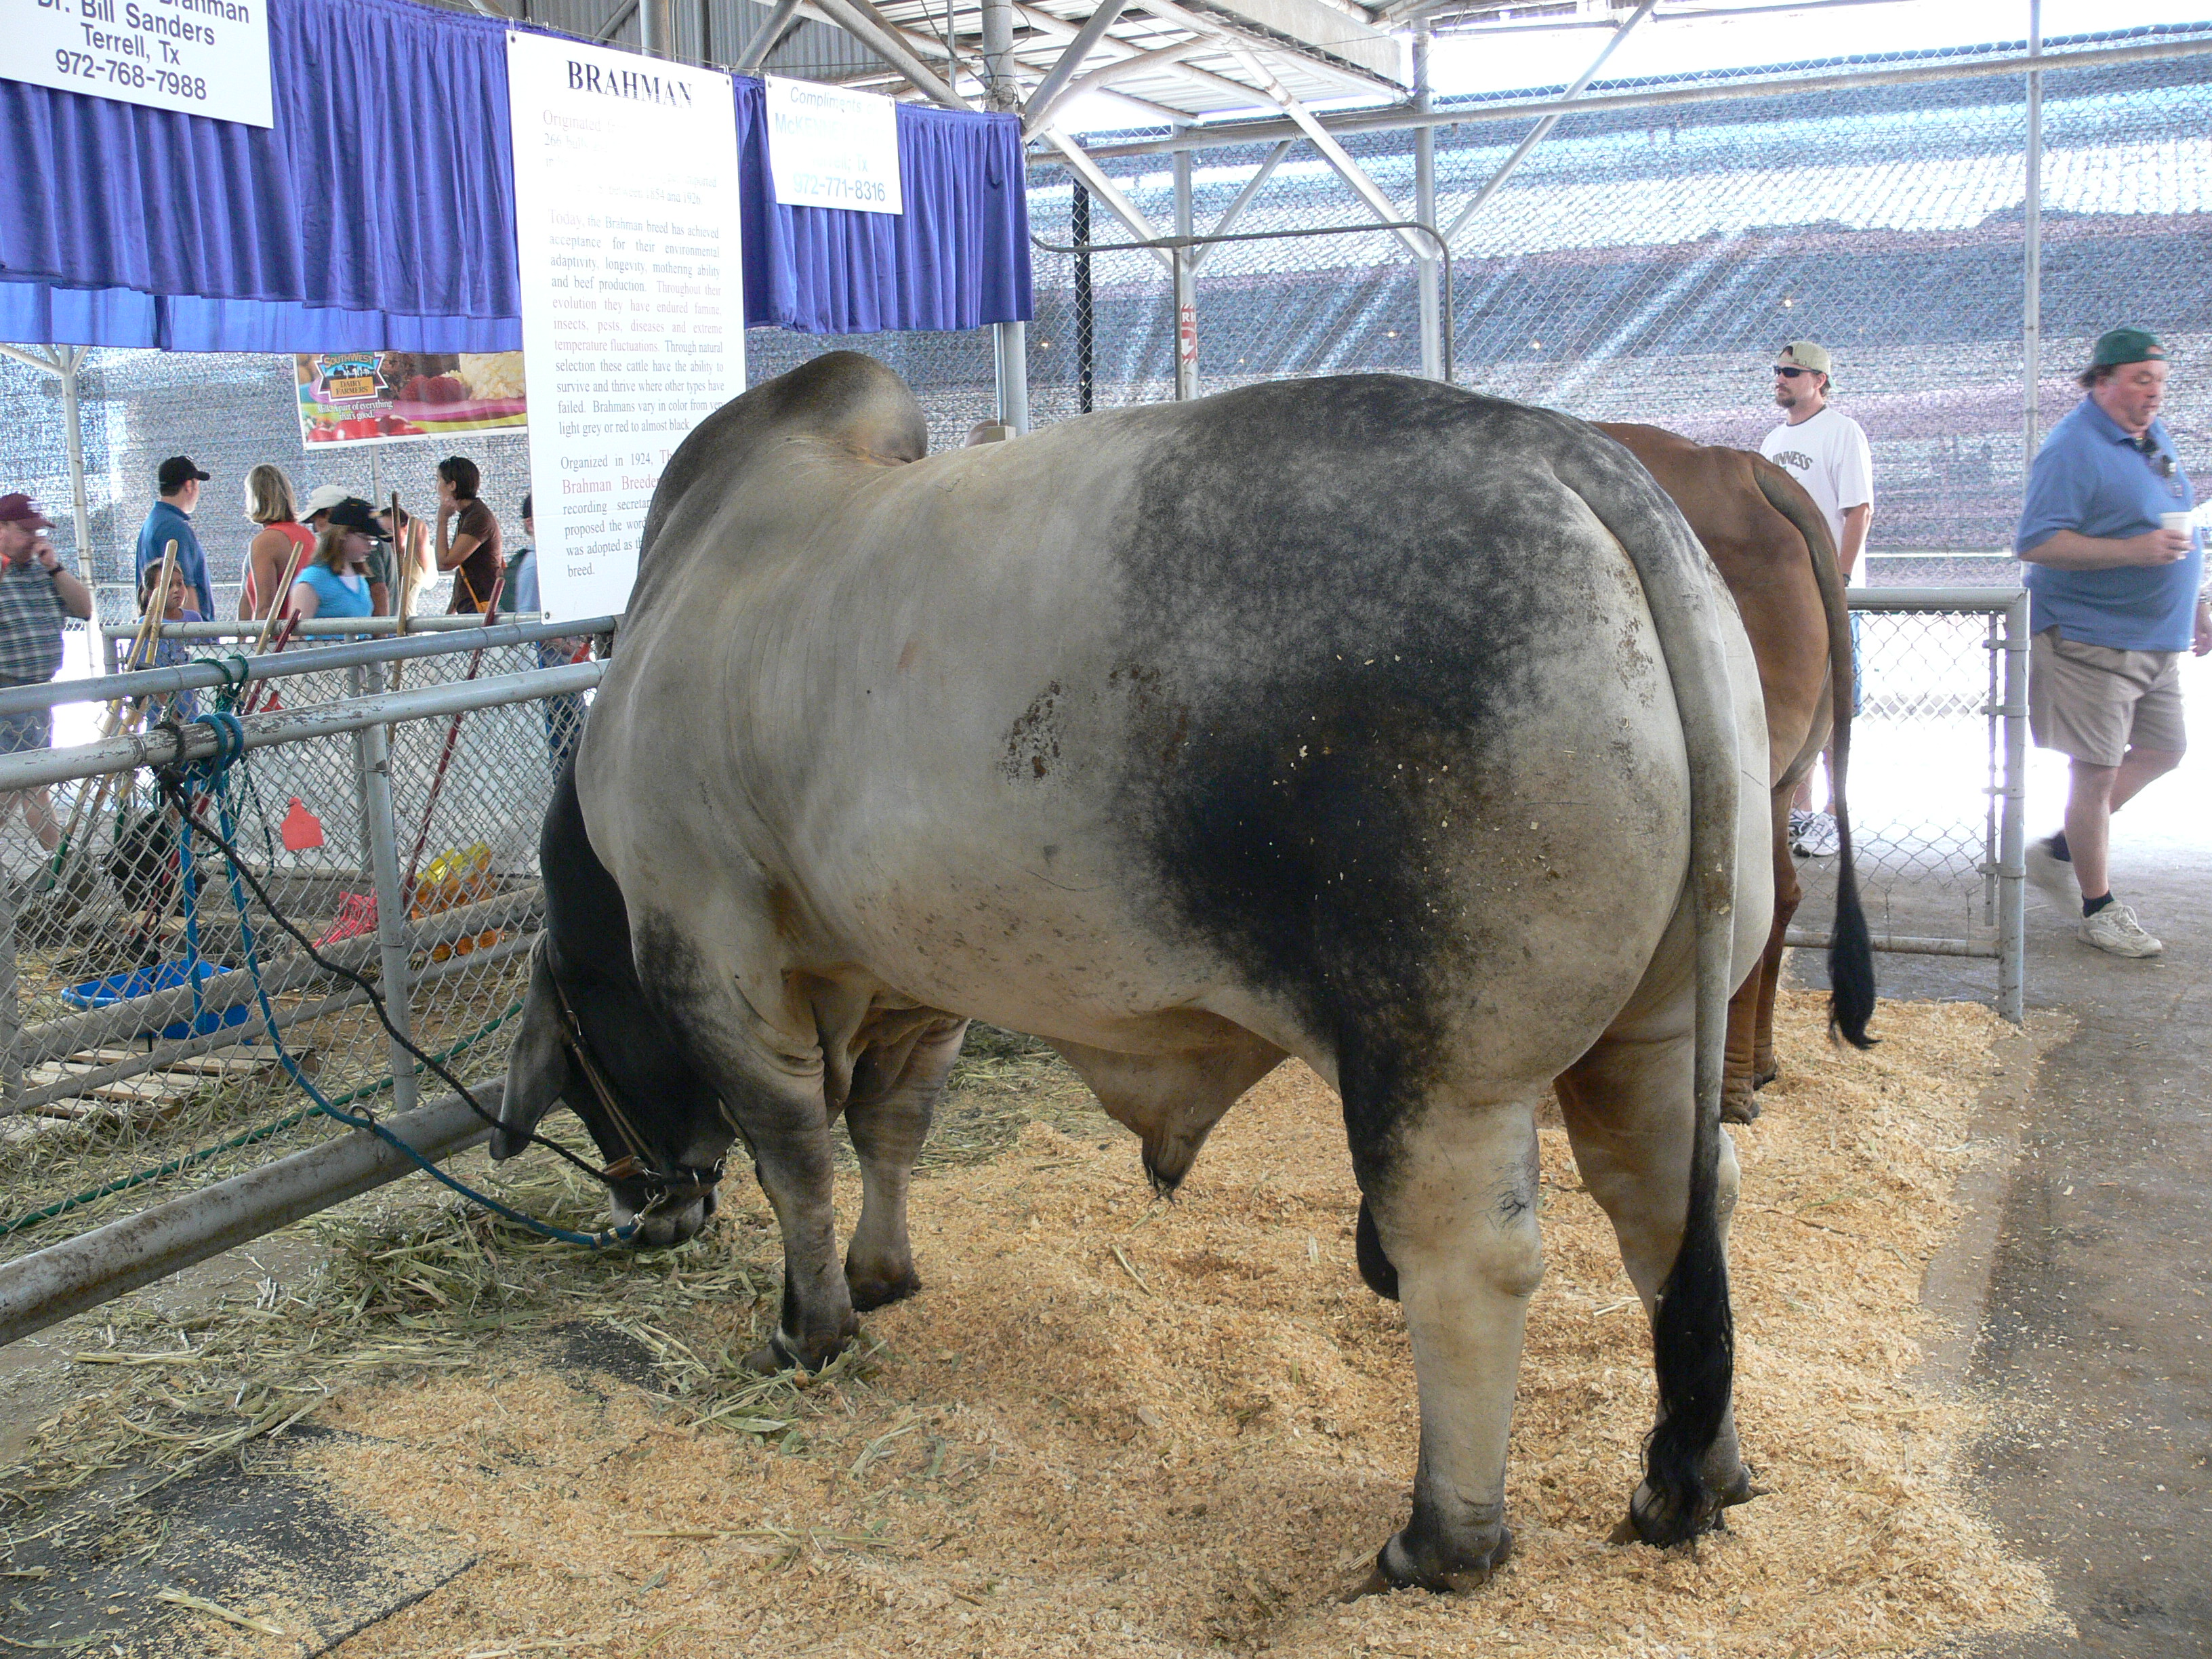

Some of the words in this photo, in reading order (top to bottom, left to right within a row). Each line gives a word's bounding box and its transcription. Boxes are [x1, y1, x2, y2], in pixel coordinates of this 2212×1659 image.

[160, 0, 249, 23] ahman
[81, 0, 115, 23] Bill
[126, 2, 215, 45] Sanders
[81, 22, 150, 63] Terrell,
[158, 40, 180, 65] Tx
[56, 49, 207, 100] 972-768-7988
[566, 60, 692, 108] BRAHMAN
[791, 86, 861, 112] Compliments
[543, 109, 601, 131] Originated
[544, 133, 561, 146] 266
[857, 154, 867, 172] Tx
[793, 172, 885, 201] 972-771-8316
[549, 209, 585, 230] Today,
[588, 215, 601, 228] the
[606, 217, 642, 231] Brahman
[647, 220, 668, 234] breed
[672, 223, 684, 234] has
[687, 225, 719, 239] achieved
[550, 236, 601, 249] acceptance
[613, 237, 626, 249] for
[636, 240, 655, 252] their
[665, 244, 720, 258] environmental
[550, 254, 599, 271] adaptivity,
[606, 257, 647, 274] longevity,
[653, 263, 692, 277] mothering
[697, 264, 720, 280] ability
[552, 275, 569, 287] and
[574, 276, 594, 289] beef
[599, 278, 647, 292] production.
[657, 280, 701, 297] Throughout
[705, 285, 721, 296] their
[552, 296, 596, 310] evolution
[605, 298, 623, 314] they
[630, 299, 650, 312] have
[657, 301, 688, 313] endured
[695, 302, 721, 316] famine,
[554, 318, 588, 331] insects,
[598, 321, 622, 333] pests,
[631, 319, 664, 332] diseases
[672, 321, 686, 333] and
[693, 325, 722, 334] extreme
[554, 340, 607, 354] temperature
[611, 338, 660, 352] fluctuations.
[665, 340, 697, 356] Through
[699, 342, 722, 353] natural
[556, 359, 595, 371] selection
[600, 359, 621, 371] these
[627, 359, 648, 372] cattle
[653, 360, 671, 371] have
[675, 360, 687, 372] the
[691, 360, 713, 375] ability
[717, 362, 724, 372] to
[340, 380, 361, 388] DAIRY
[557, 380, 590, 393] survive
[593, 380, 608, 392] and
[612, 380, 636, 392] thrive
[638, 380, 662, 392] where
[665, 380, 684, 391] other
[687, 381, 705, 394] types
[708, 380, 724, 391] have
[339, 403, 351, 412] part
[352, 401, 359, 409] of
[360, 400, 393, 410] everything
[340, 412, 356, 420] that's
[356, 410, 375, 421] good.
[558, 401, 586, 414] failed.
[593, 400, 635, 413] Brahmans
[638, 401, 655, 415] vary
[659, 399, 666, 411] in
[668, 399, 687, 411] color
[691, 398, 708, 410] from
[559, 422, 580, 437] light
[583, 424, 601, 436] grey
[605, 424, 613, 433] or
[616, 421, 629, 433] red
[631, 422, 638, 432] to
[641, 419, 667, 432] almost
[670, 417, 691, 430] black.
[560, 455, 608, 472] Organized
[615, 456, 623, 467] in
[631, 453, 653, 466] 1924,
[1773, 451, 1813, 470] INNESS
[562, 478, 612, 494] Brahman
[621, 474, 660, 490] Breeder
[562, 500, 607, 515] recording
[617, 499, 651, 511] secretar
[565, 520, 605, 539] proposed
[609, 519, 621, 531] the
[566, 546, 583, 556] was
[587, 539, 620, 556] adopted
[624, 541, 632, 550] as
[568, 562, 594, 577] breed.
